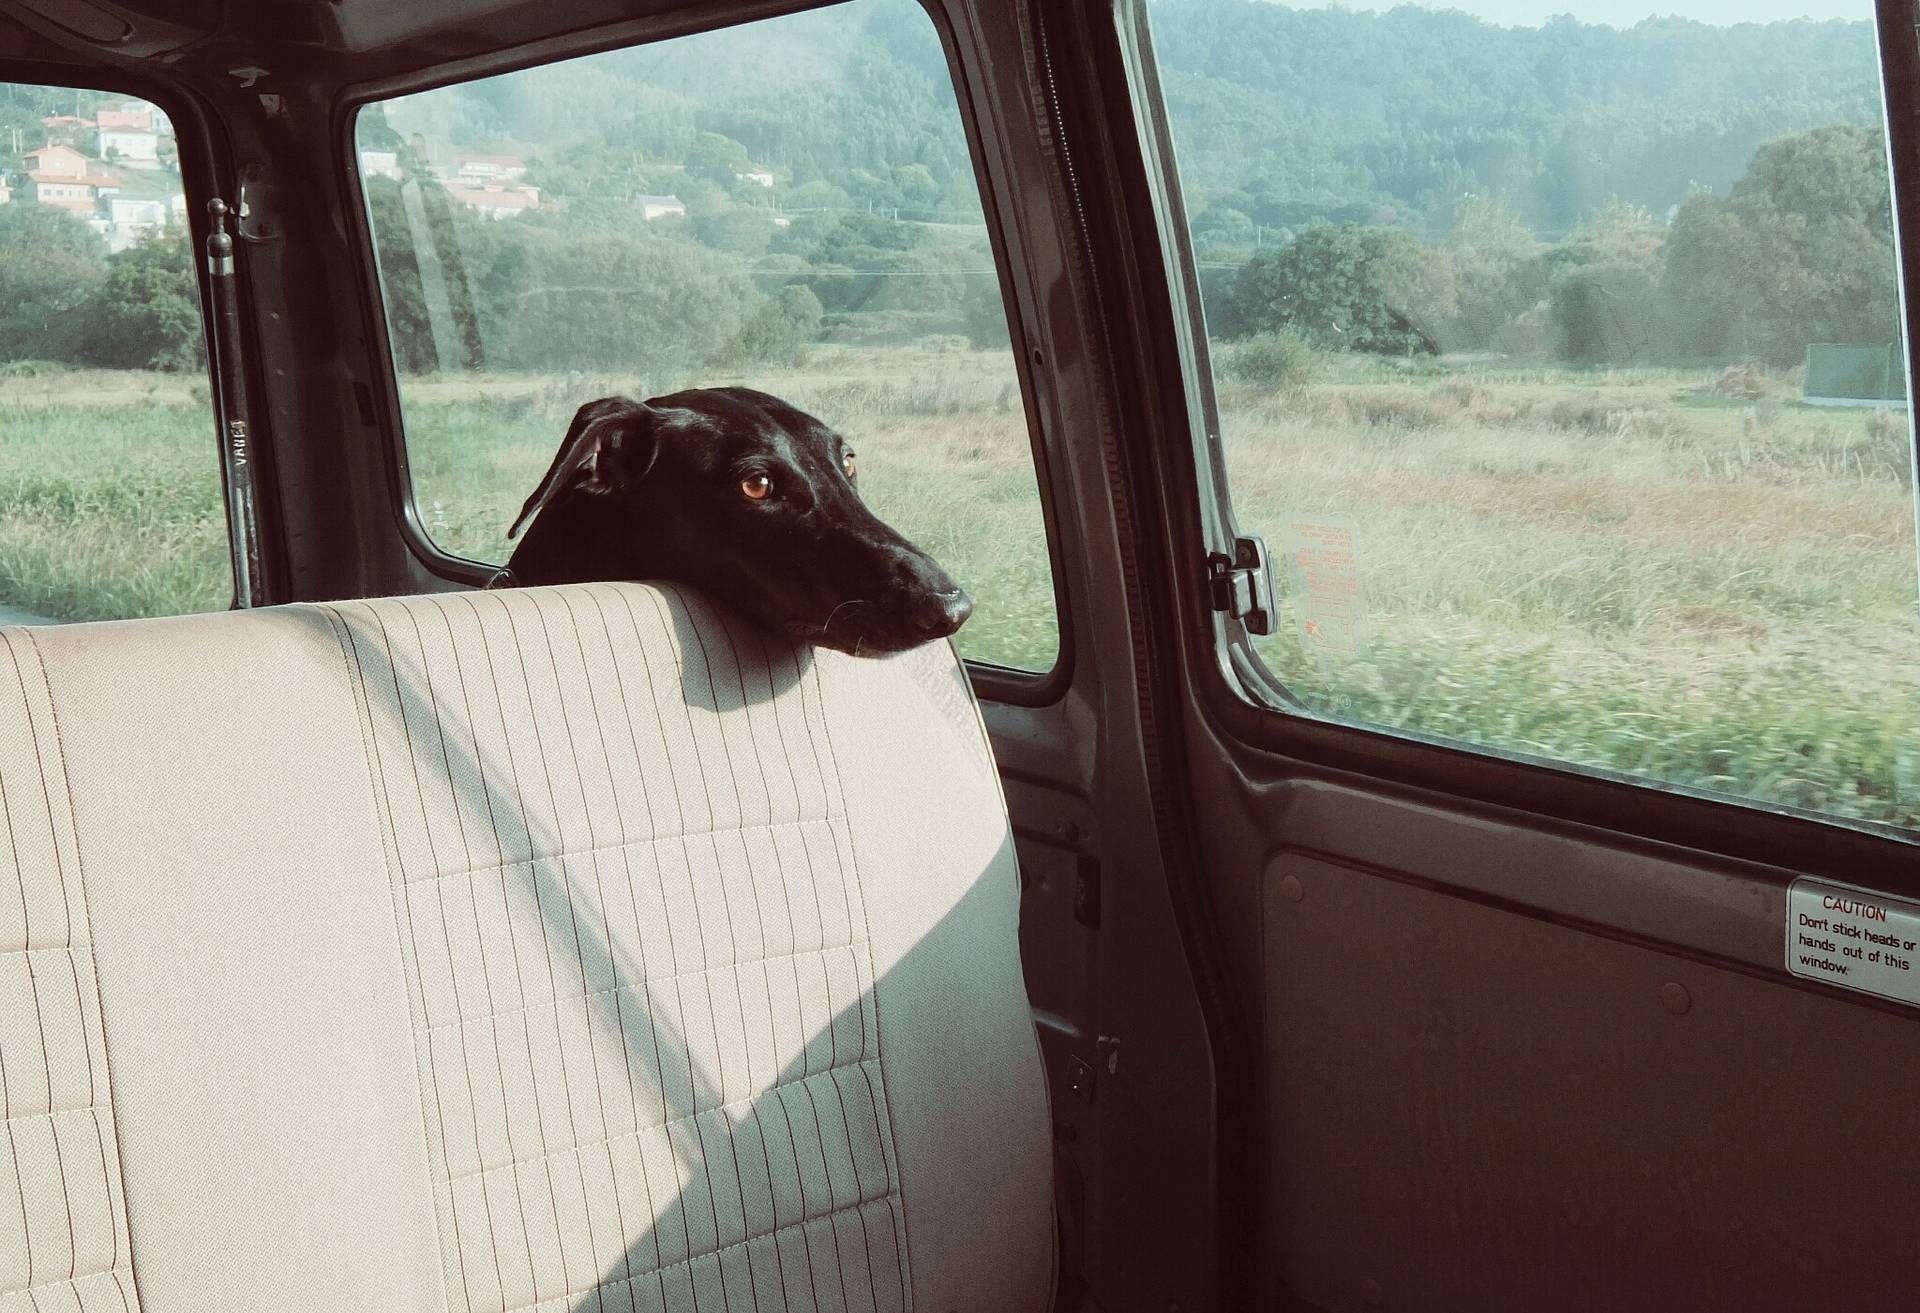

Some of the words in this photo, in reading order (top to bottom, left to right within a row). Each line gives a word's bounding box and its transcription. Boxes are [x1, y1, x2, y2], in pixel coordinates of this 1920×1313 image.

[1823, 895, 1887, 922] CAUTION
[1799, 913, 1828, 931] Don't
[1832, 923, 1861, 939] stick
[1864, 928, 1900, 948] heads
[1903, 940, 1917, 951] or
[1799, 932, 1836, 952] hands
[1842, 946, 1863, 959] out
[1868, 951, 1881, 962] of
[1884, 953, 1910, 970] this
